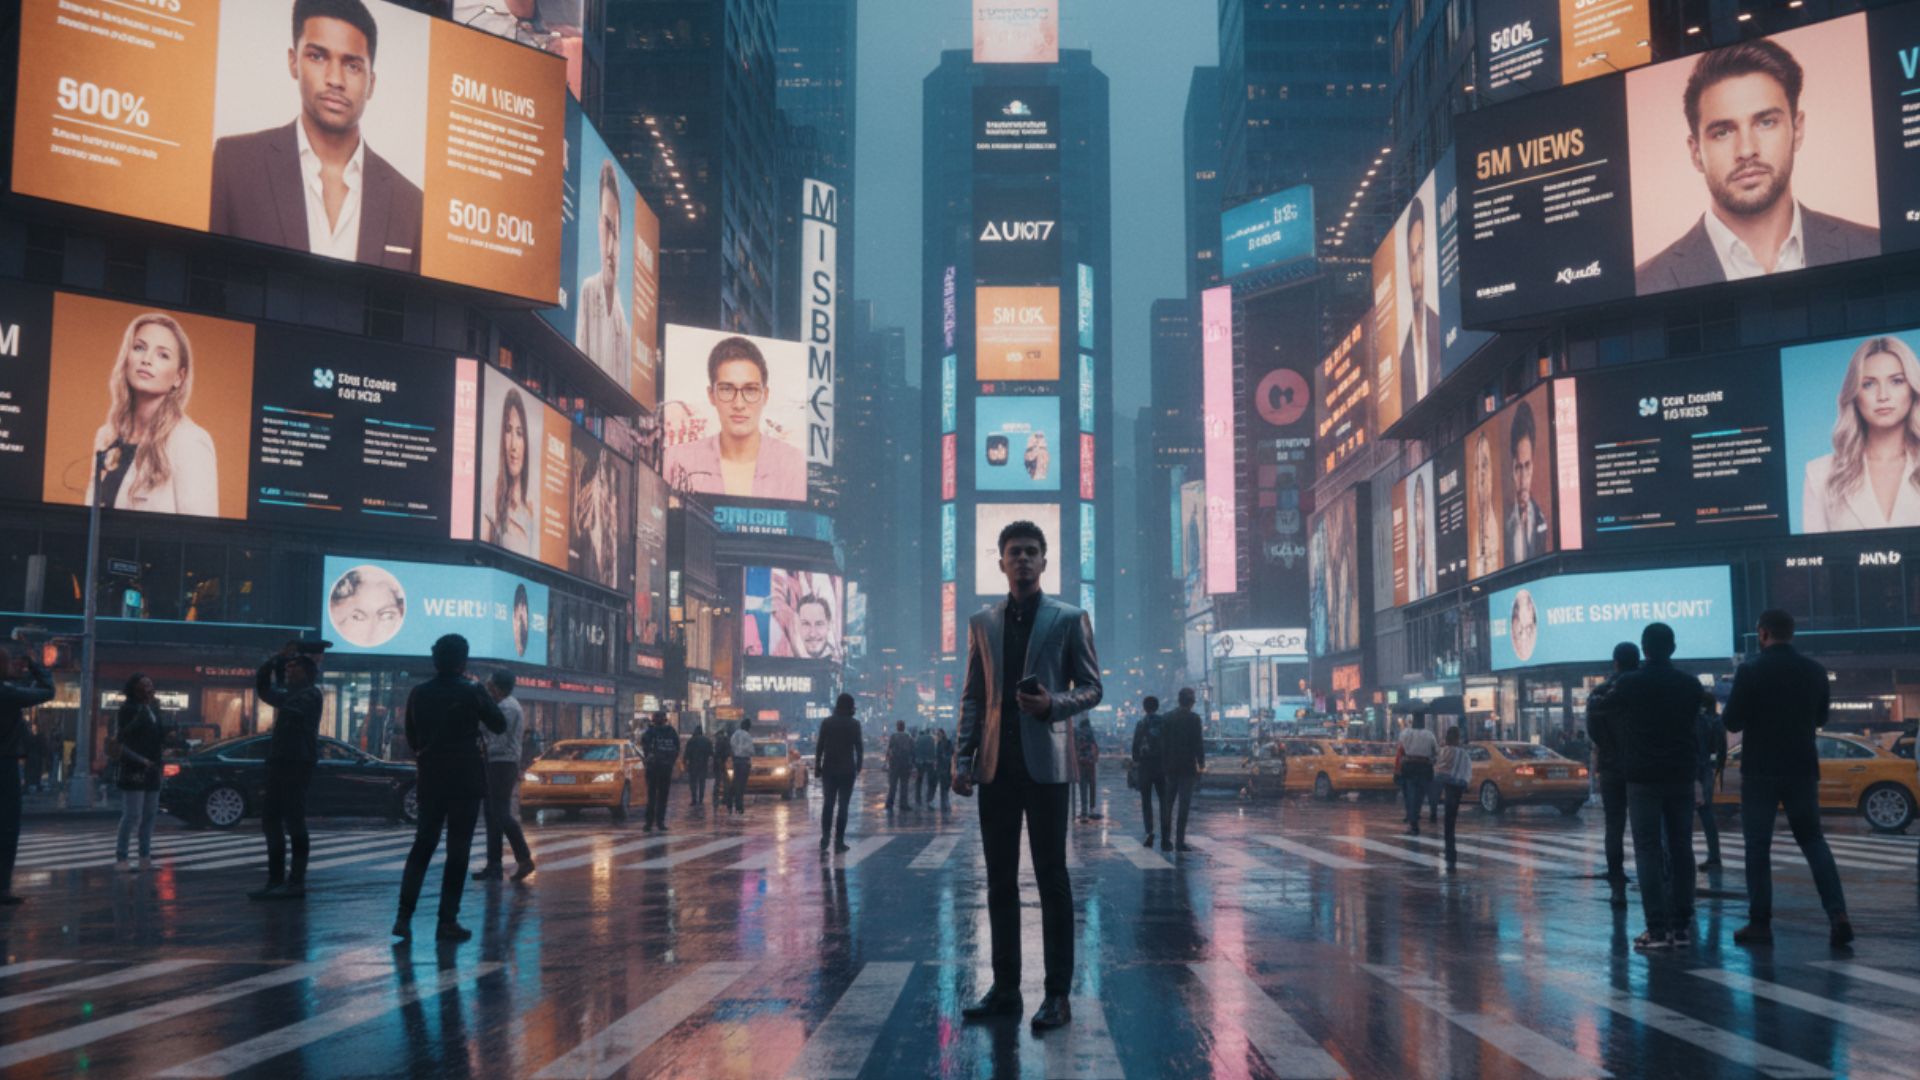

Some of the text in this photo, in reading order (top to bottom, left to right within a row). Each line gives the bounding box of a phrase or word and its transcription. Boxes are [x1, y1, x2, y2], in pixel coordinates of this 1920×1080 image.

[57, 76, 150, 128] 500%
[1476, 128, 1585, 180] 5M VIEWS
